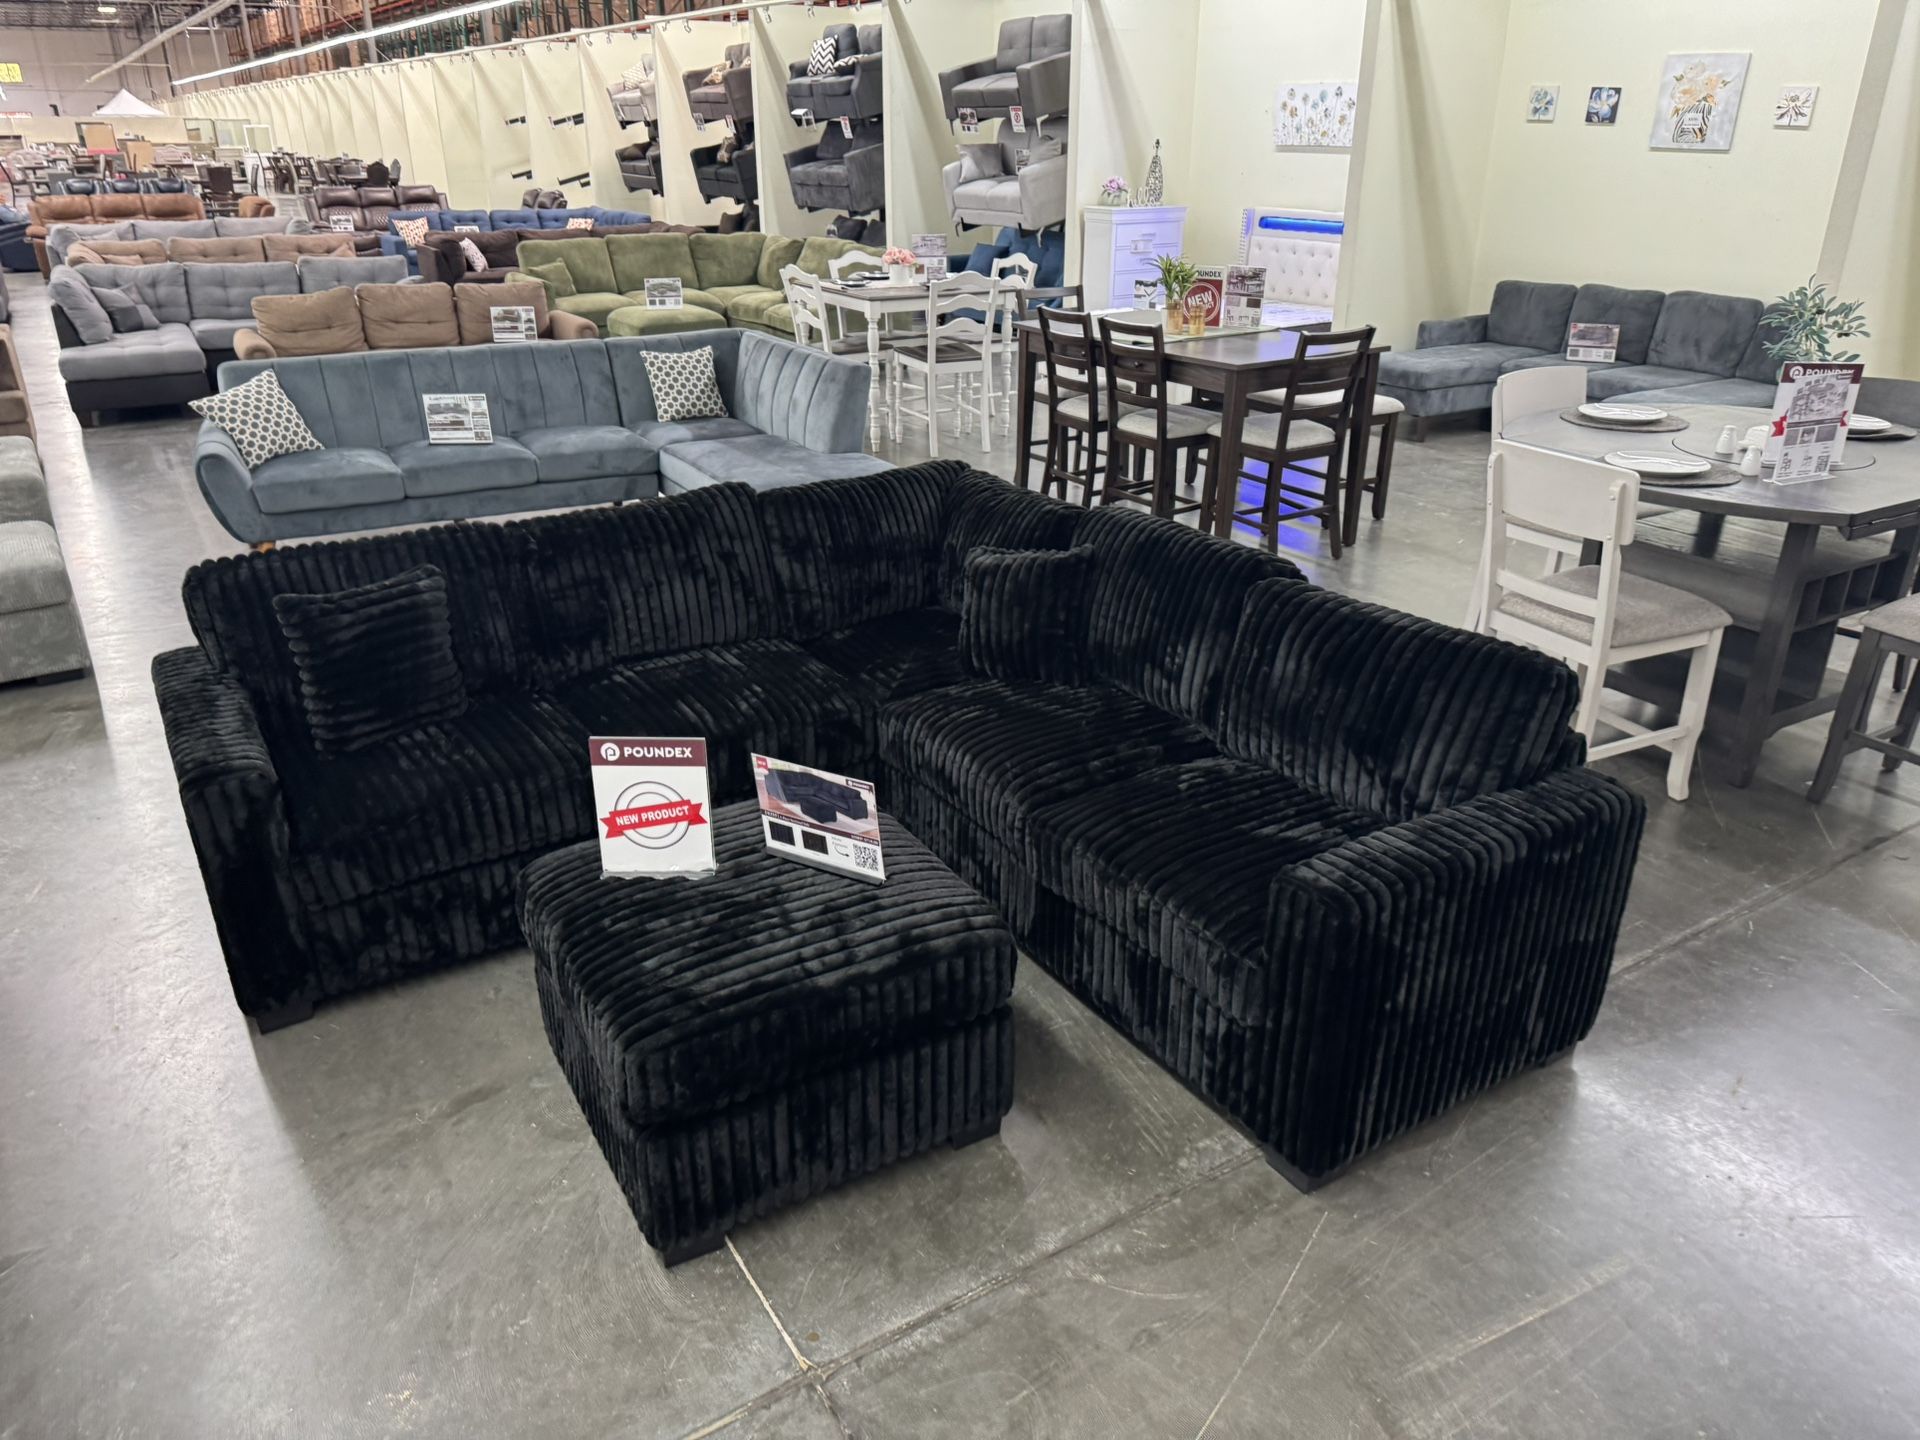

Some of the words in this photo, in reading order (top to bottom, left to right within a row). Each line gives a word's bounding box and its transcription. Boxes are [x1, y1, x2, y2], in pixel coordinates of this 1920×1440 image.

[1187, 290, 1213, 308] NEW
[623, 746, 692, 758] POUNDEX
[615, 813, 639, 826] NEW
[641, 805, 690, 822] PRODUCT
